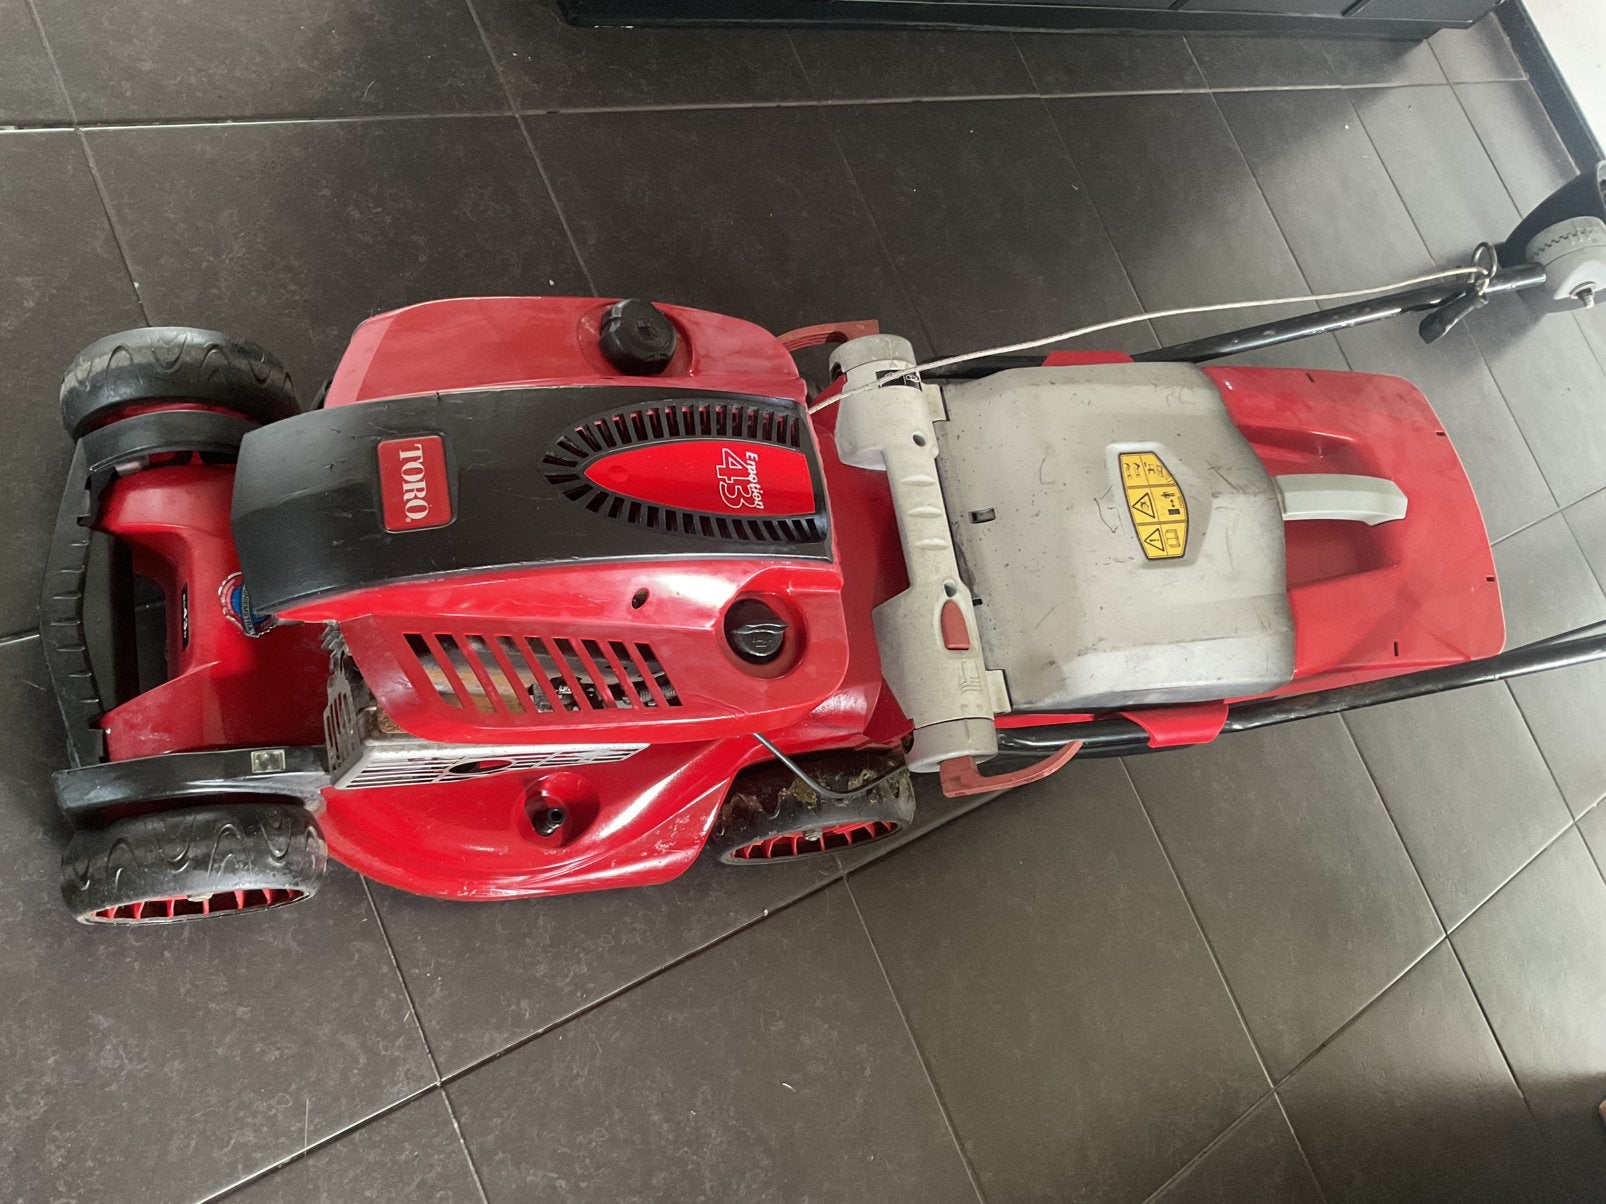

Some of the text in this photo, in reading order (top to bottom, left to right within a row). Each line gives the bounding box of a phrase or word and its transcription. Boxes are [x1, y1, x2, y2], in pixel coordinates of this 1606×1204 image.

[399, 443, 429, 520] TORO
[716, 447, 757, 509] 43
[745, 451, 765, 510] Emotion
